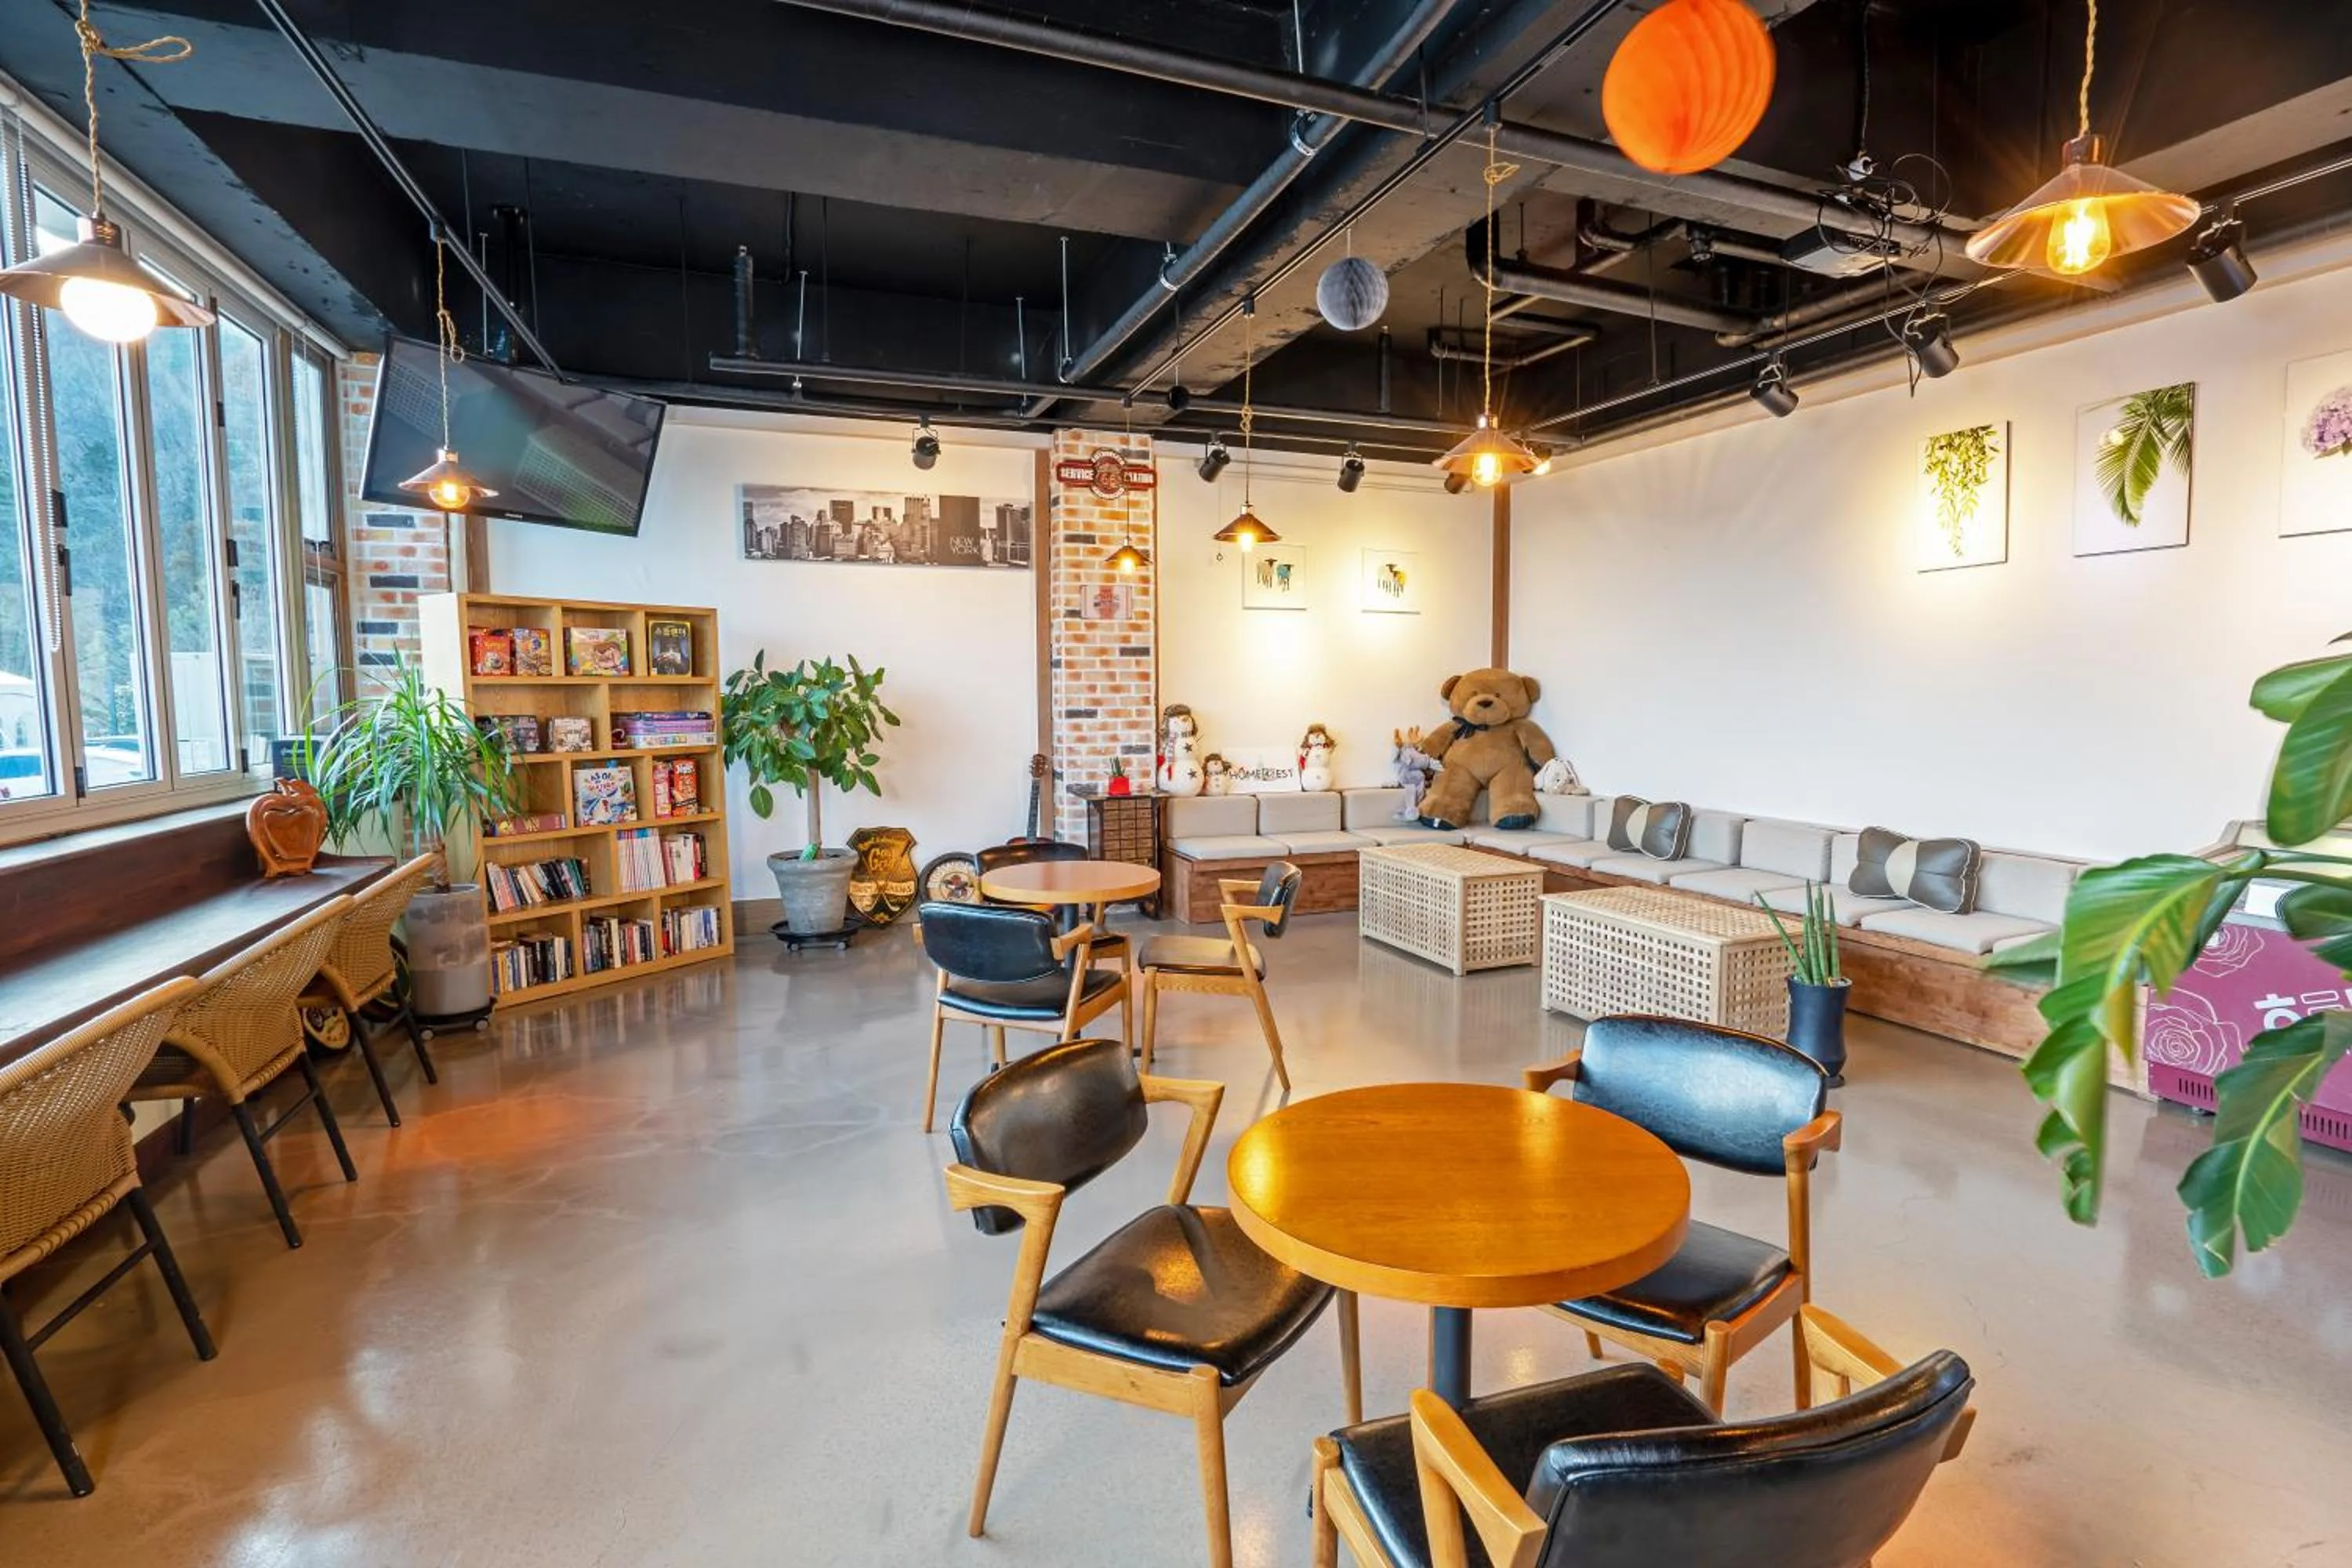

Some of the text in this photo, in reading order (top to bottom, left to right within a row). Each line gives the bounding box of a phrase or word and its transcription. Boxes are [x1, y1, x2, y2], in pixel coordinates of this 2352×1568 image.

[1061, 468, 1094, 481] SERVICE
[949, 536, 974, 547] NEW
[951, 545, 979, 555] YORK
